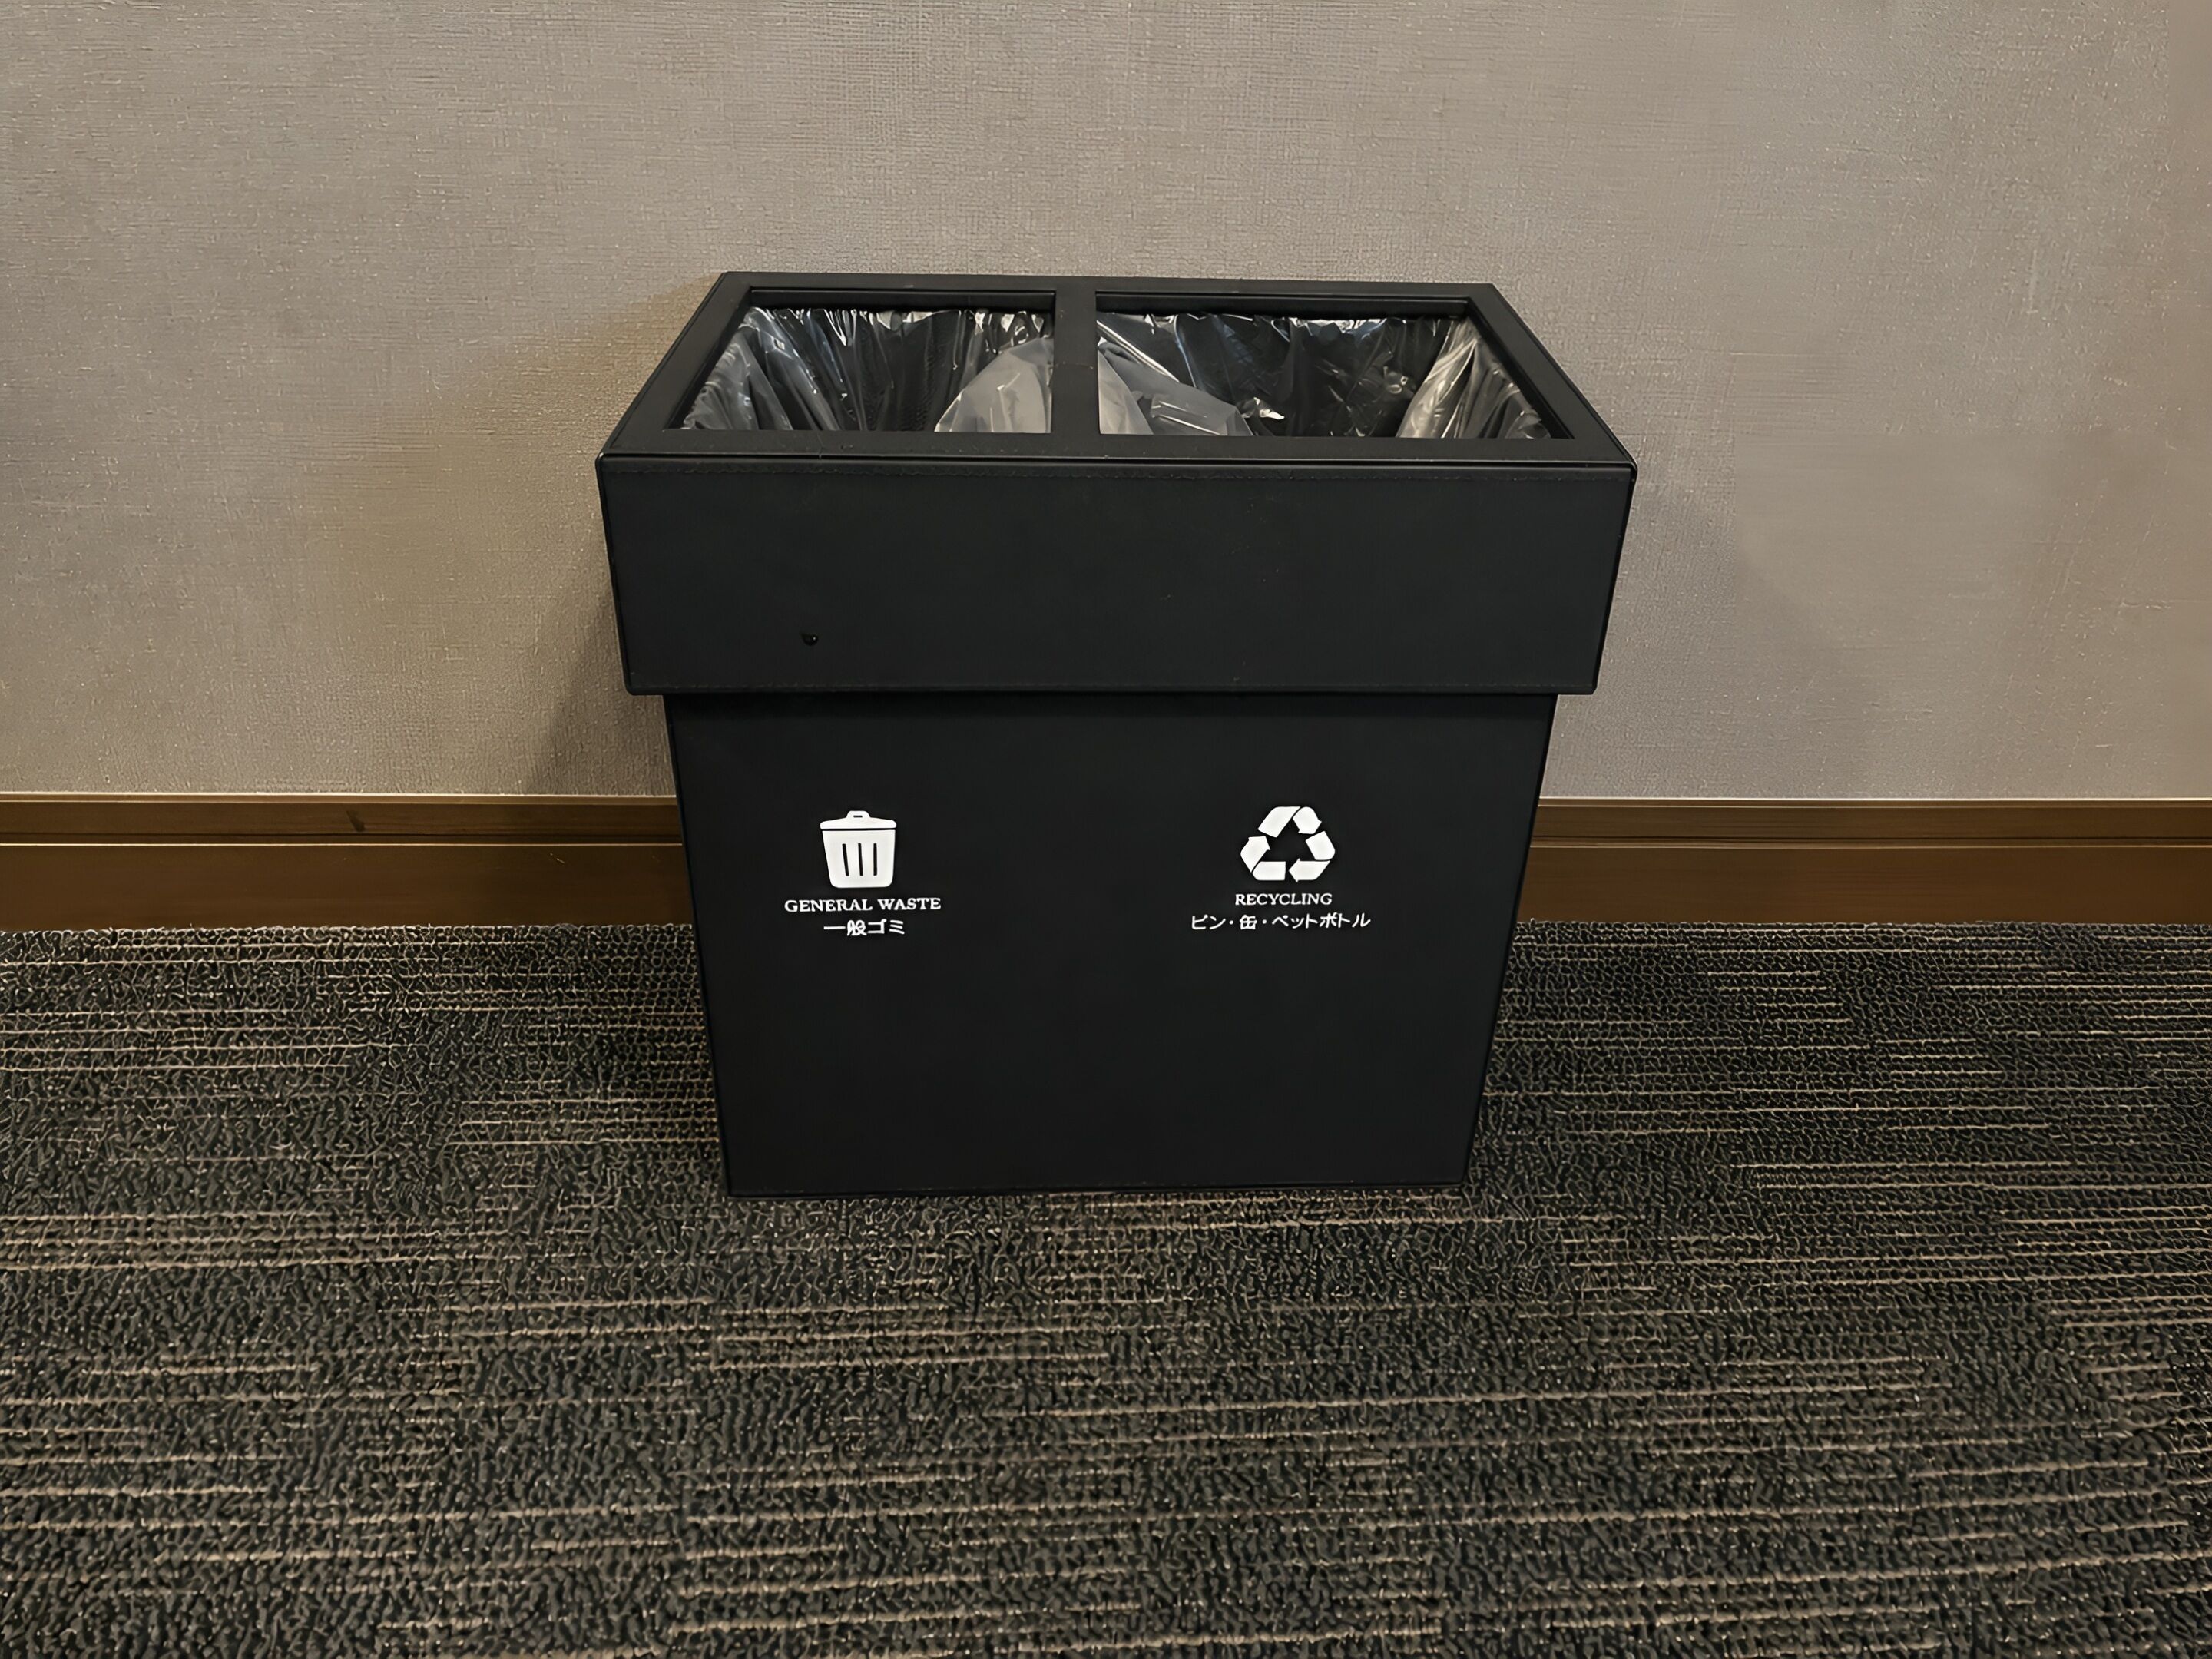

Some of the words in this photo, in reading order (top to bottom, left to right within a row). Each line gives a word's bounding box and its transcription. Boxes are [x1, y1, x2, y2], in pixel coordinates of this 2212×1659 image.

[784, 899, 873, 912] GENERAL
[877, 897, 942, 912] WASTE
[1234, 892, 1333, 906] RECYCLING
[823, 919, 906, 936] 一般ゴミ
